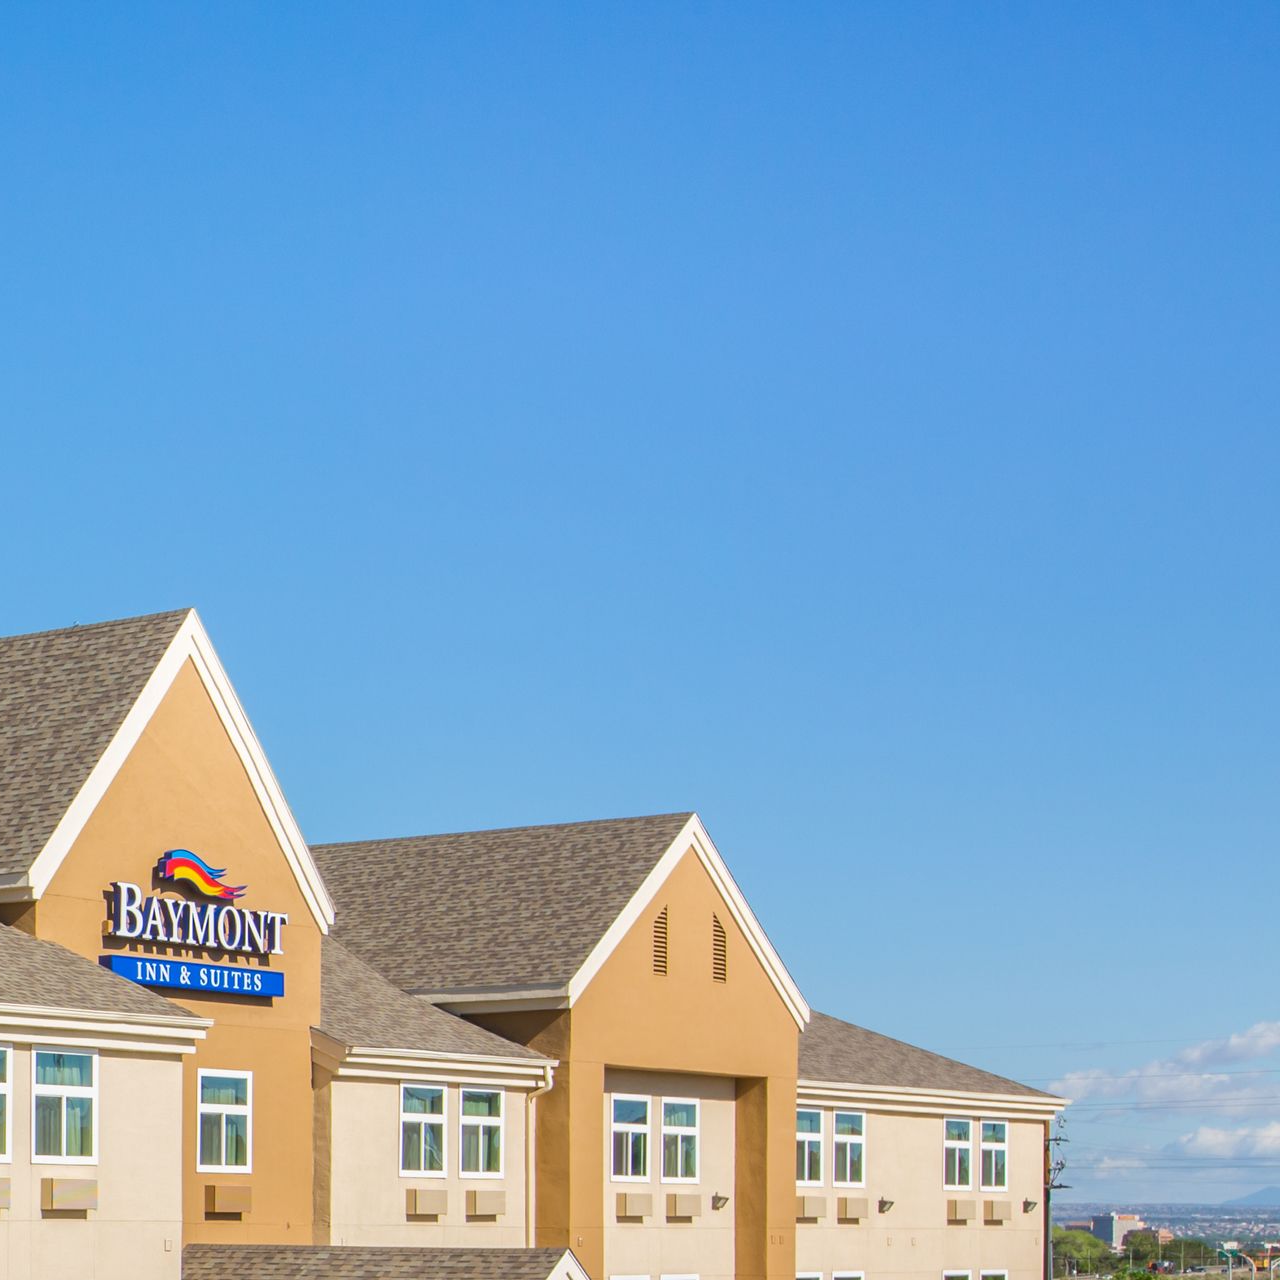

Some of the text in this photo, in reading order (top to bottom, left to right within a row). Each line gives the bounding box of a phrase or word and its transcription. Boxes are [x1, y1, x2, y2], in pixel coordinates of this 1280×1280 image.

[116, 882, 289, 955] BAYMONT
[137, 961, 262, 991] INN & SUITES
